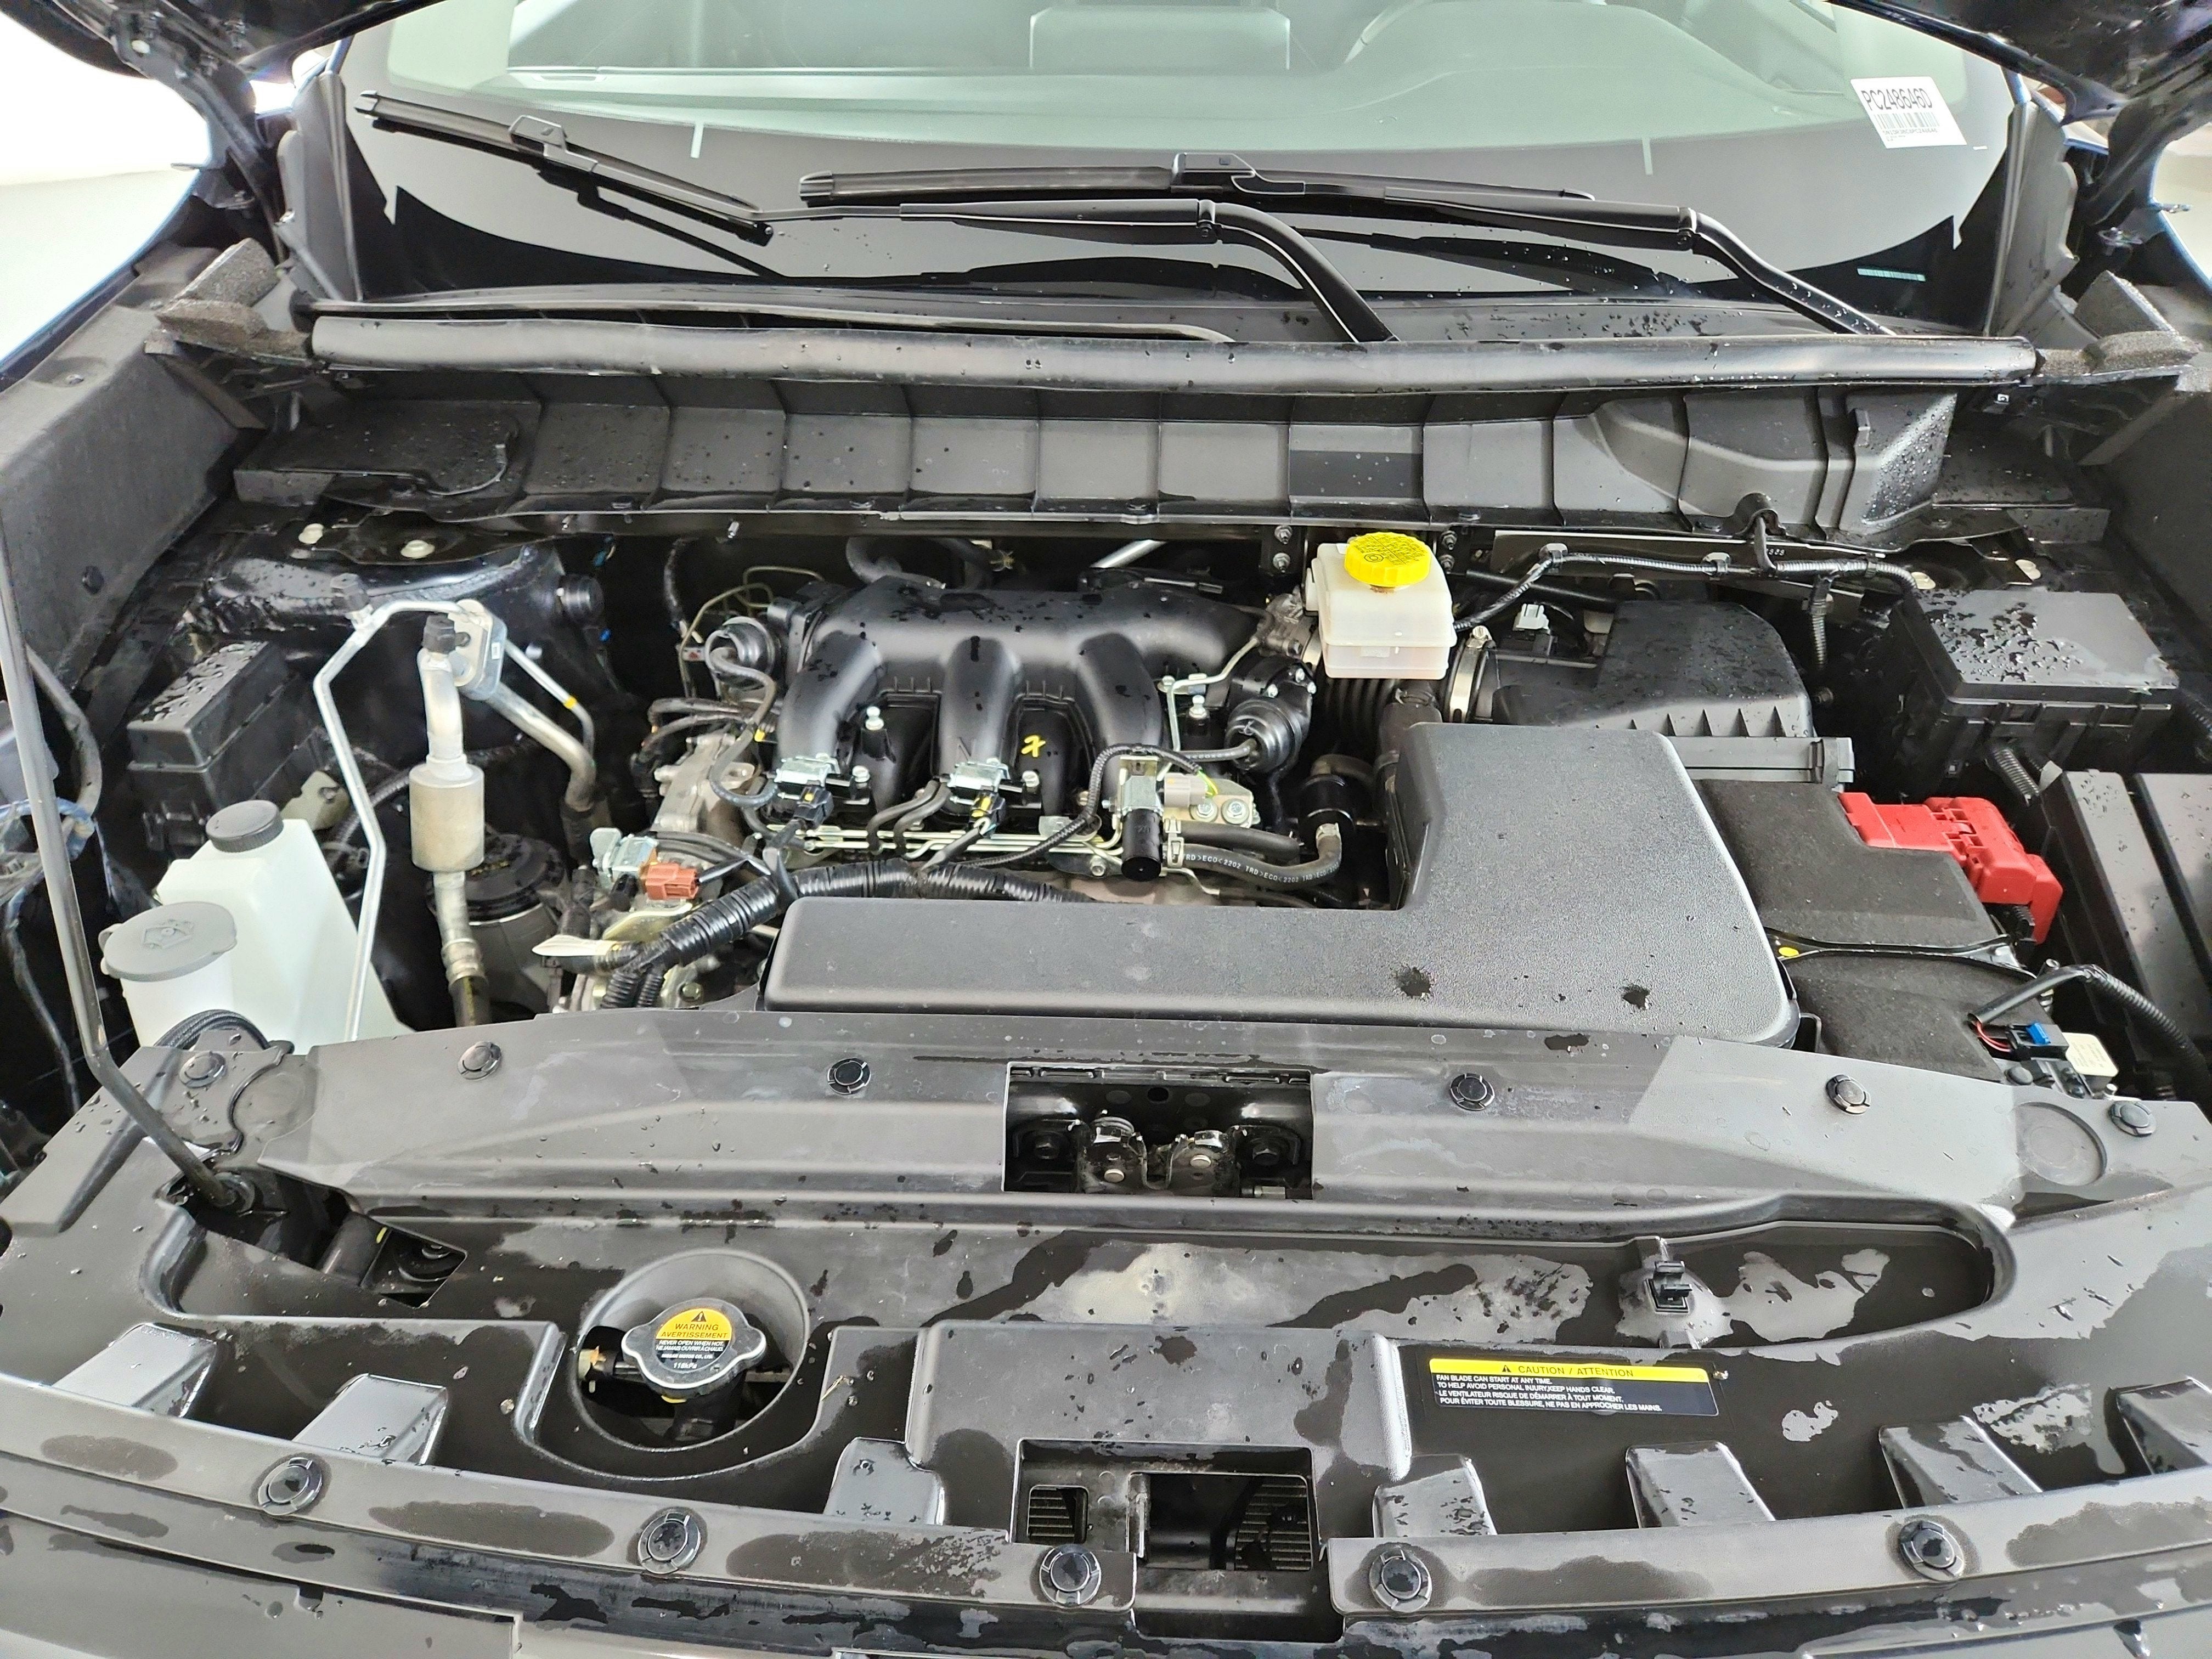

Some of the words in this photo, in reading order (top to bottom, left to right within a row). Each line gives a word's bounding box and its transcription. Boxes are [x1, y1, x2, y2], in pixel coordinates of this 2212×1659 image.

[1861, 88, 1932, 111] PC248646D
[1518, 1365, 1565, 1375] CAUTION
[1577, 1367, 1634, 1377] ATTENTION
[1462, 1397, 1483, 1406] ÉVITER
[1530, 1392, 1566, 1401] DÉMARRER
